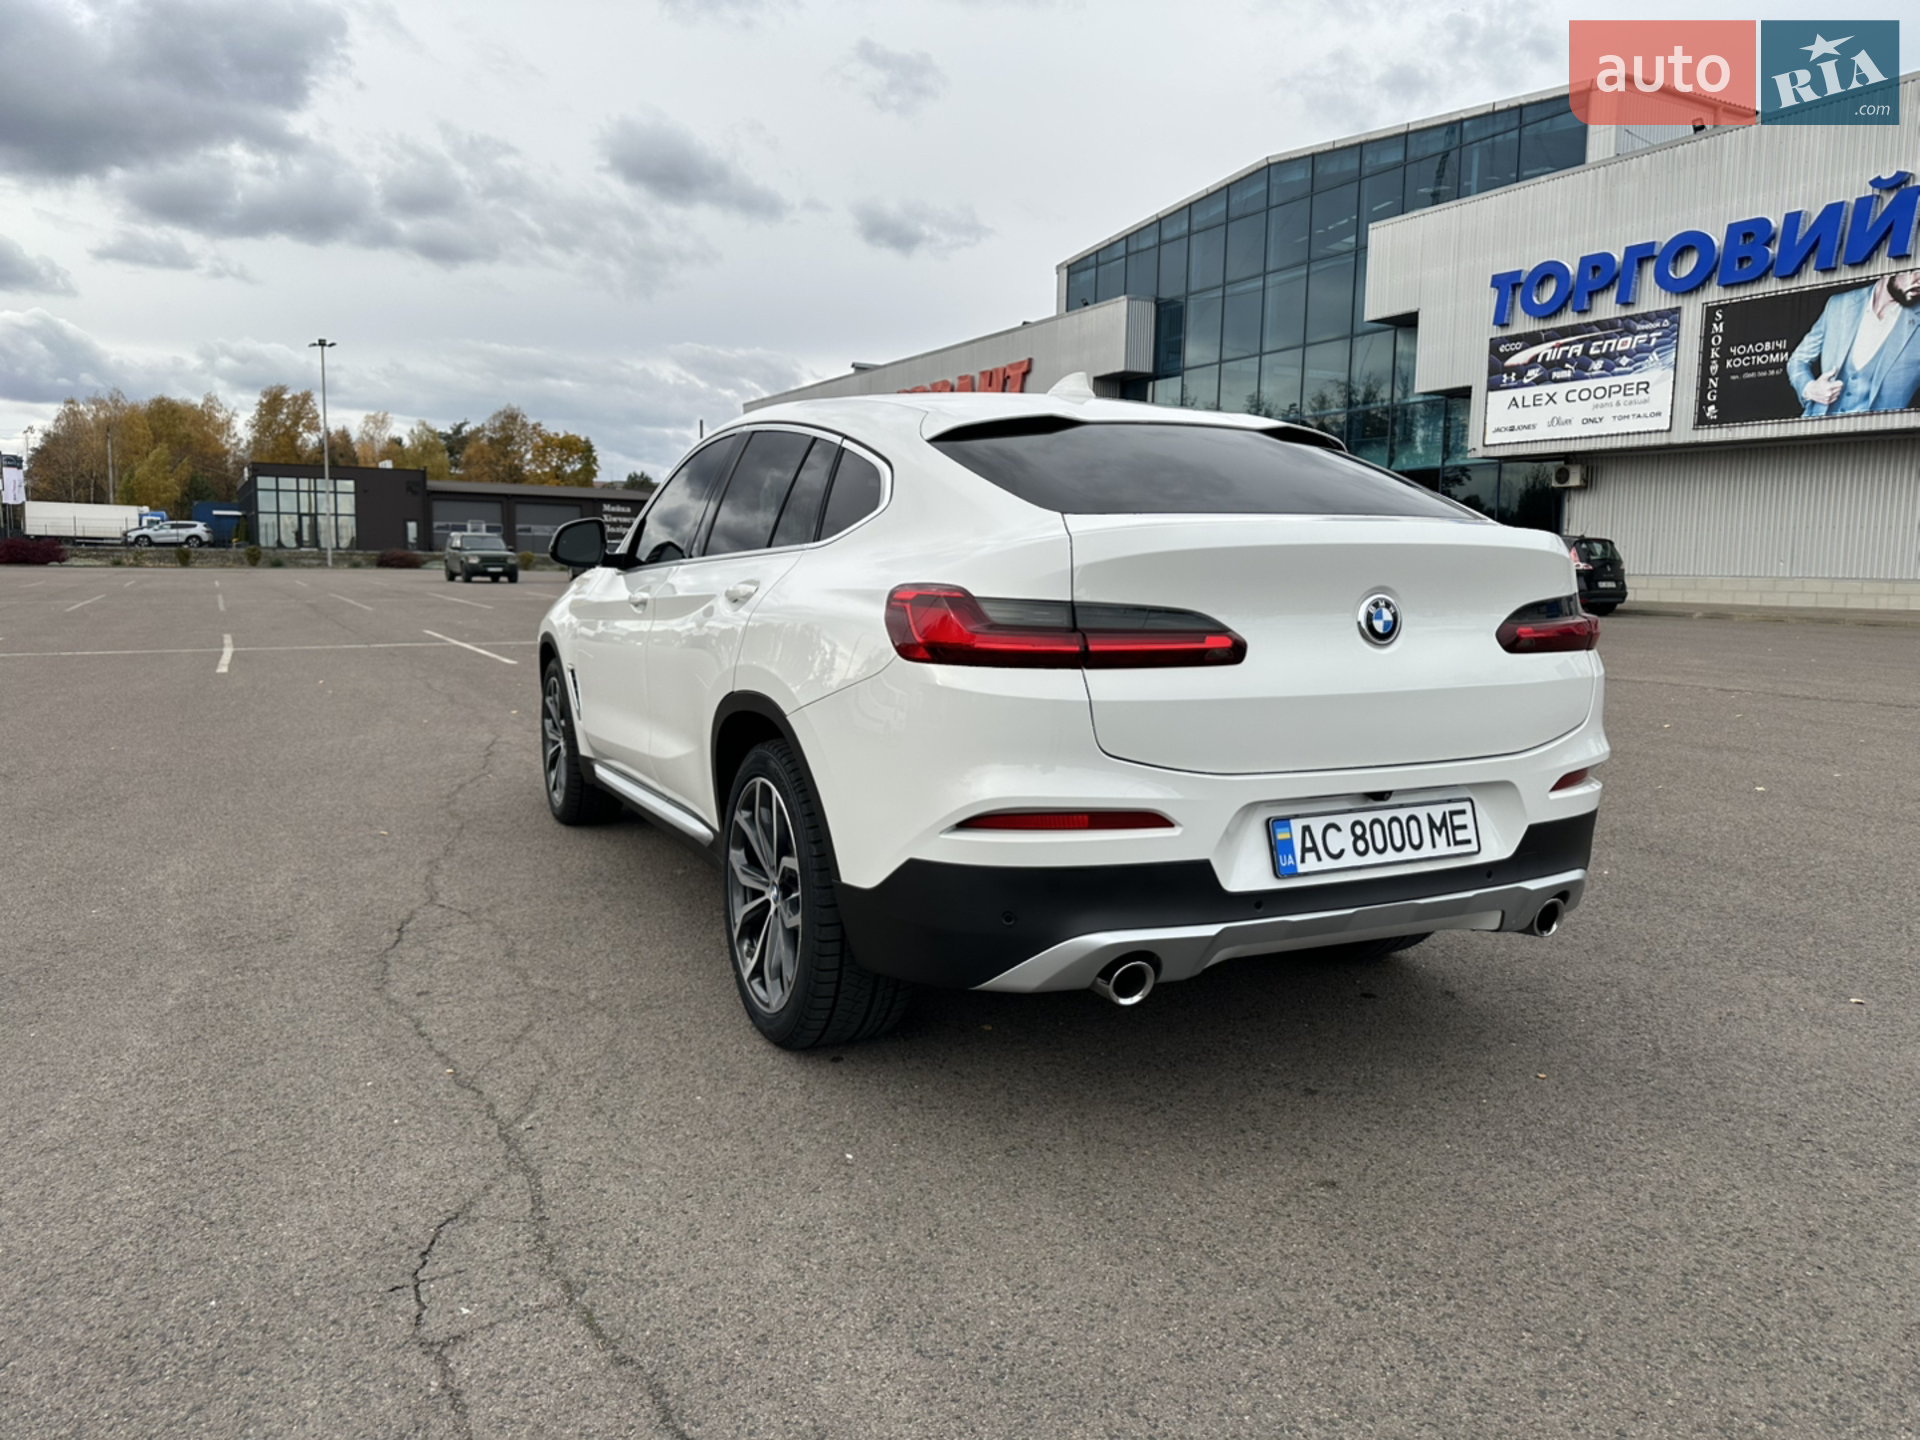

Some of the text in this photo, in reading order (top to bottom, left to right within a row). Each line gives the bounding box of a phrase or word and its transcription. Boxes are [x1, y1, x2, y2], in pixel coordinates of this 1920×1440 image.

[1490, 171, 1920, 326] ТОРГОВИЙ
[1730, 339, 1787, 356] ЧОЛОВІЧІ
[1726, 352, 1789, 369] КОСТЮМИ
[1507, 380, 1650, 410] ALEX COOPER
[1591, 400, 1613, 411] jeans
[1623, 397, 1650, 407] casual
[1581, 416, 1604, 425] ONLY
[1300, 809, 1472, 864] AC 8000 ME
[1280, 854, 1295, 866] UA
